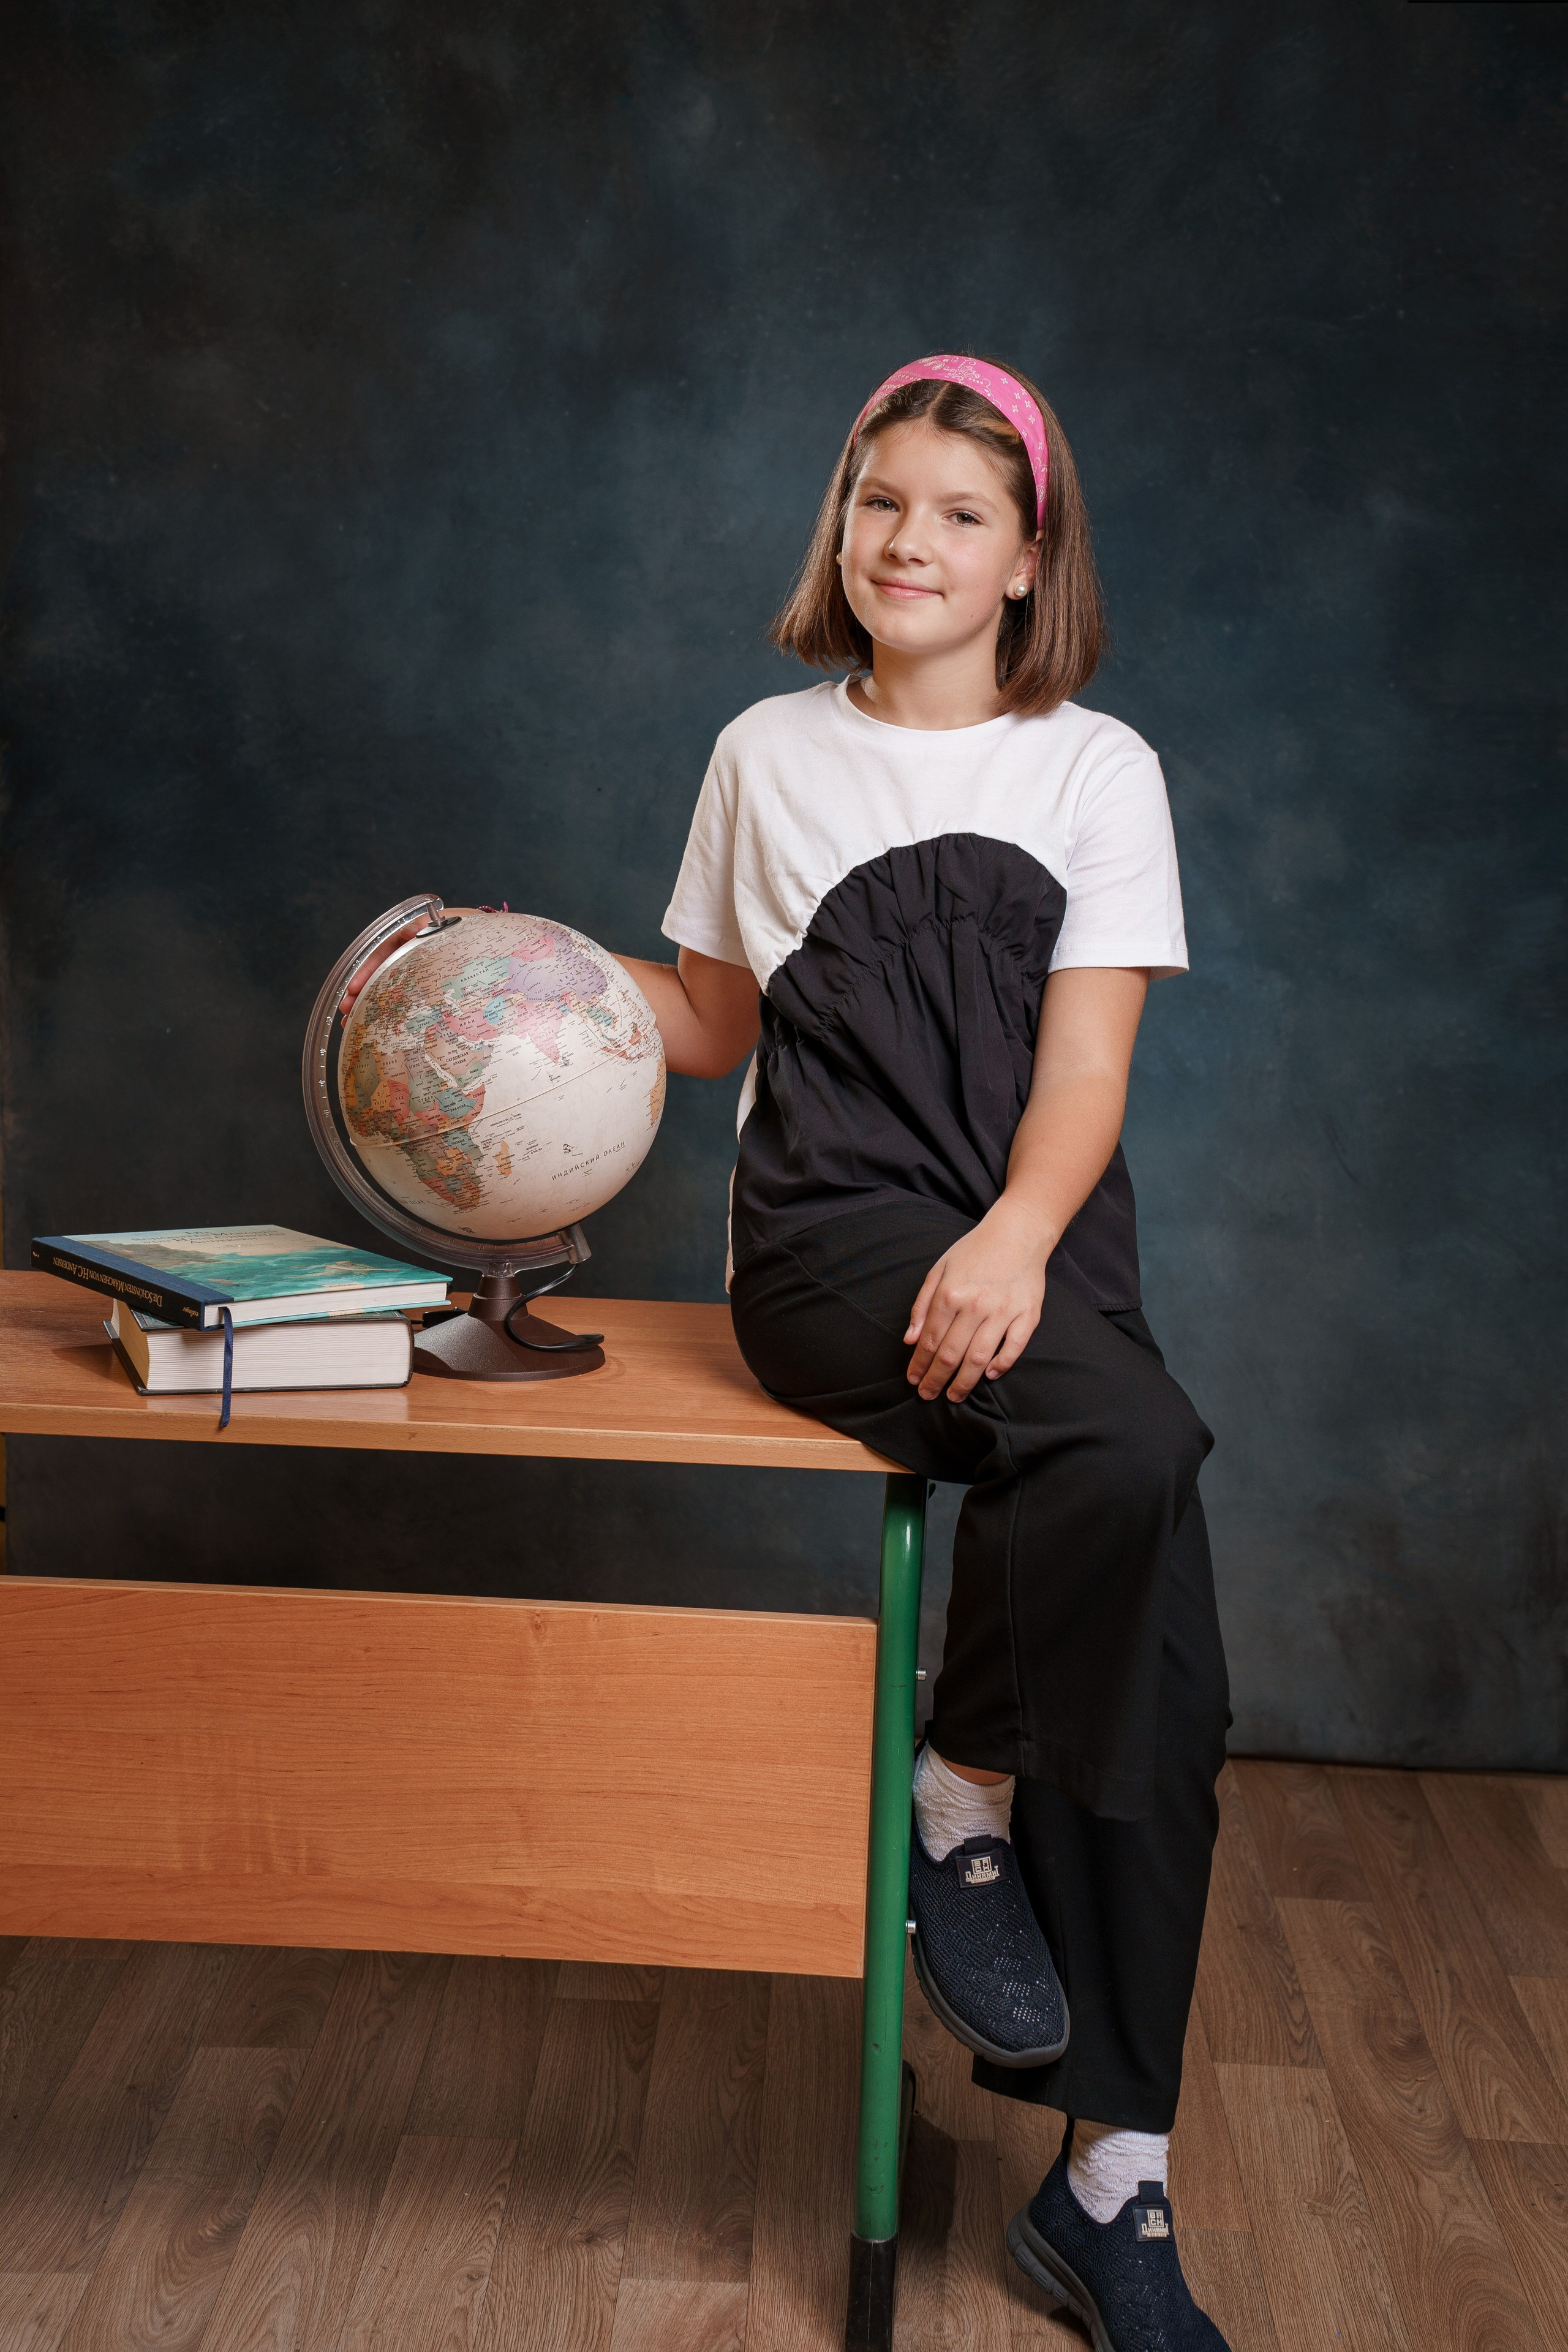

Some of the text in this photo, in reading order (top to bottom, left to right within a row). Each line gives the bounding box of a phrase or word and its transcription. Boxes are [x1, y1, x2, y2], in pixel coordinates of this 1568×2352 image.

[530, 944, 547, 955] МОНГОЛИЯ
[461, 968, 489, 982] КАЗАХСТАН
[461, 987, 482, 998] УЗБЕКИСТАН
[483, 1008, 503, 1019] АФГАНИСТАН
[460, 1019, 475, 1028] ИРАН
[497, 1017, 514, 1027] ПАКИСТАН
[446, 1052, 469, 1063] САУДОВСКАЯ
[430, 1059, 453, 1083] КРАСНОЕ МОРЕ
[450, 1104, 466, 1112] ЭФИОПИЯ
[552, 1141, 625, 1180] ИНДИЙСКИЙ ОКЕАН
